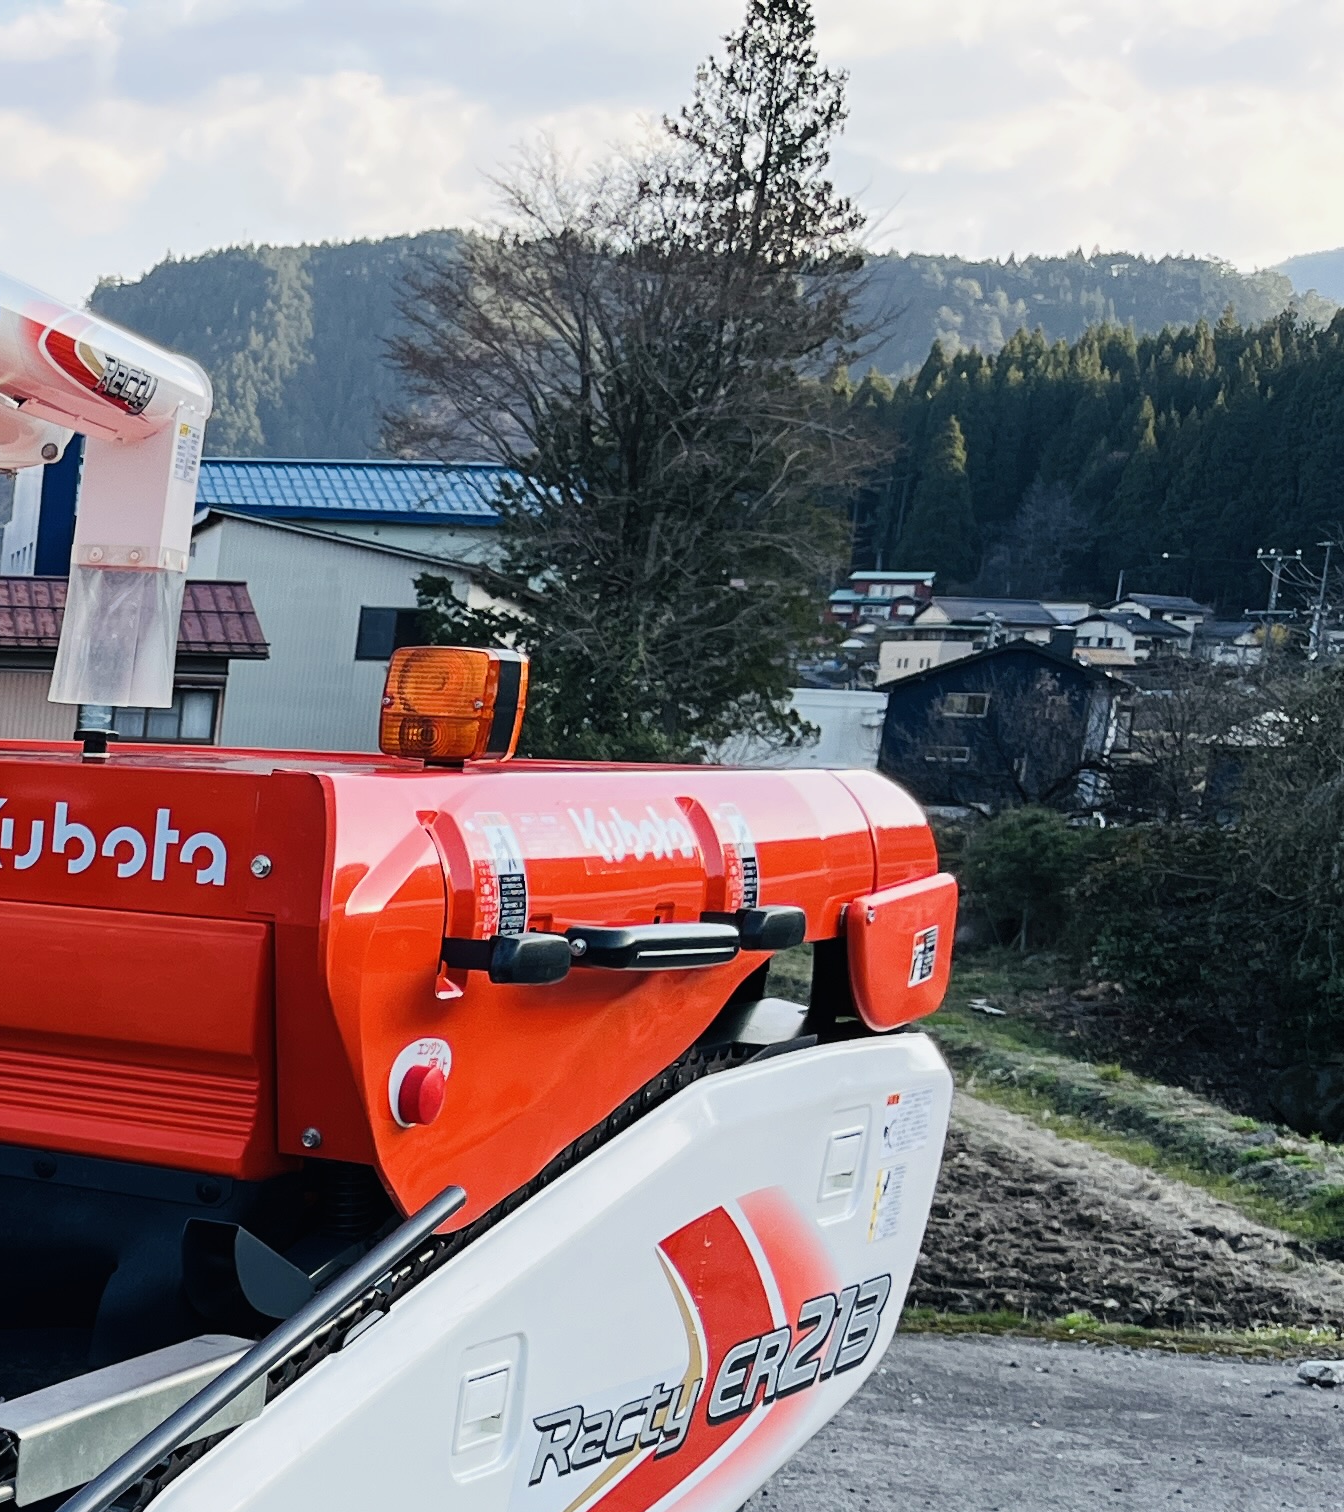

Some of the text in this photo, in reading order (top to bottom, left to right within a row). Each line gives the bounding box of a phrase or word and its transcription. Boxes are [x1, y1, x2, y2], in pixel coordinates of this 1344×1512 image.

[93, 353, 158, 415] Racty
[567, 805, 695, 863] Kubota
[417, 1041, 443, 1055] エンジン
[528, 1273, 892, 1487] Racty ER213
